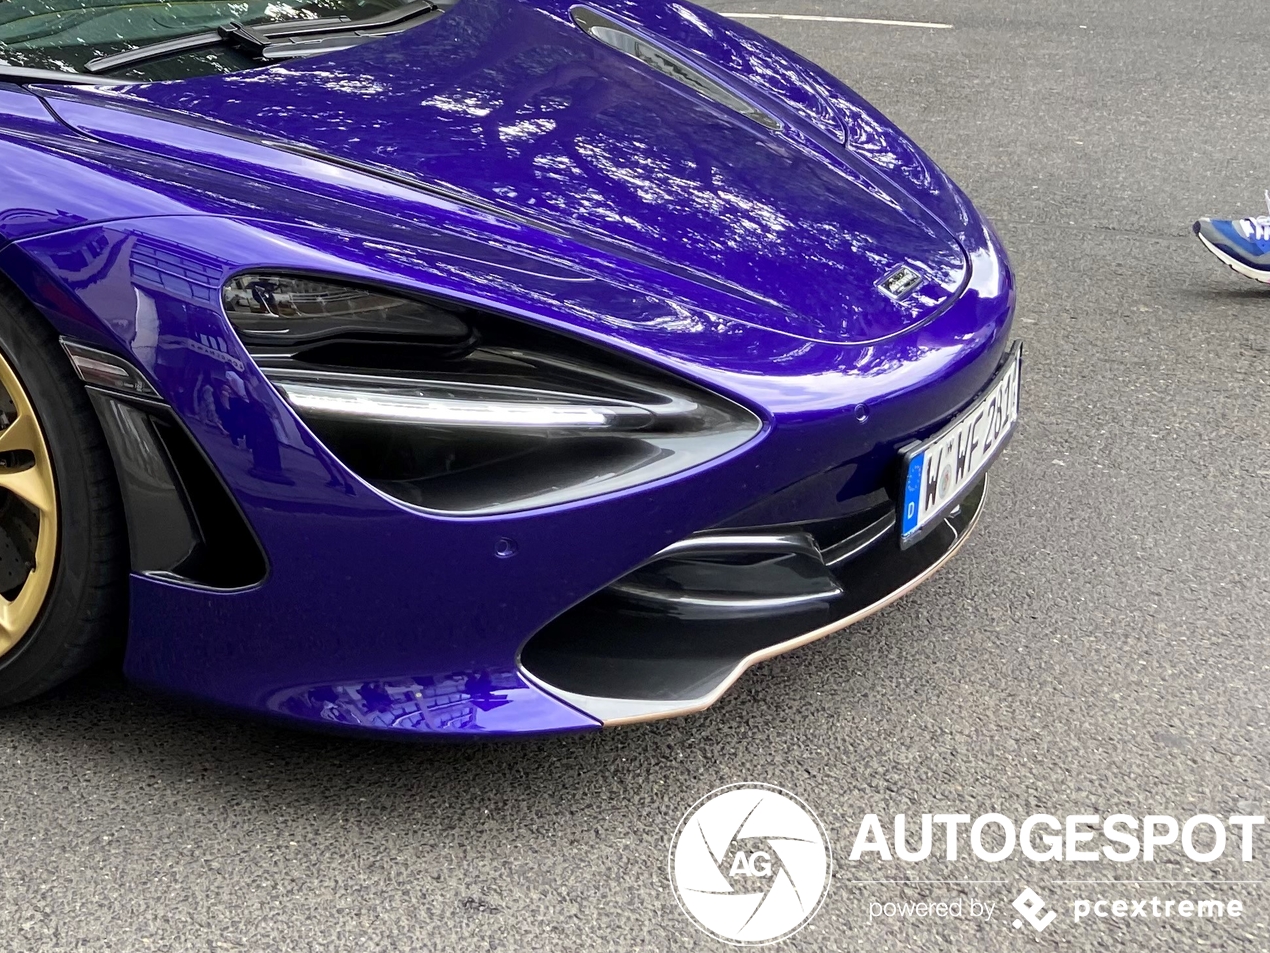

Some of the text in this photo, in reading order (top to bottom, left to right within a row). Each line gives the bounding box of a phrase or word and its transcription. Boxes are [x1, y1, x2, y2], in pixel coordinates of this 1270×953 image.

[925, 374, 1011, 511] W WF 281
[907, 501, 915, 519] D
